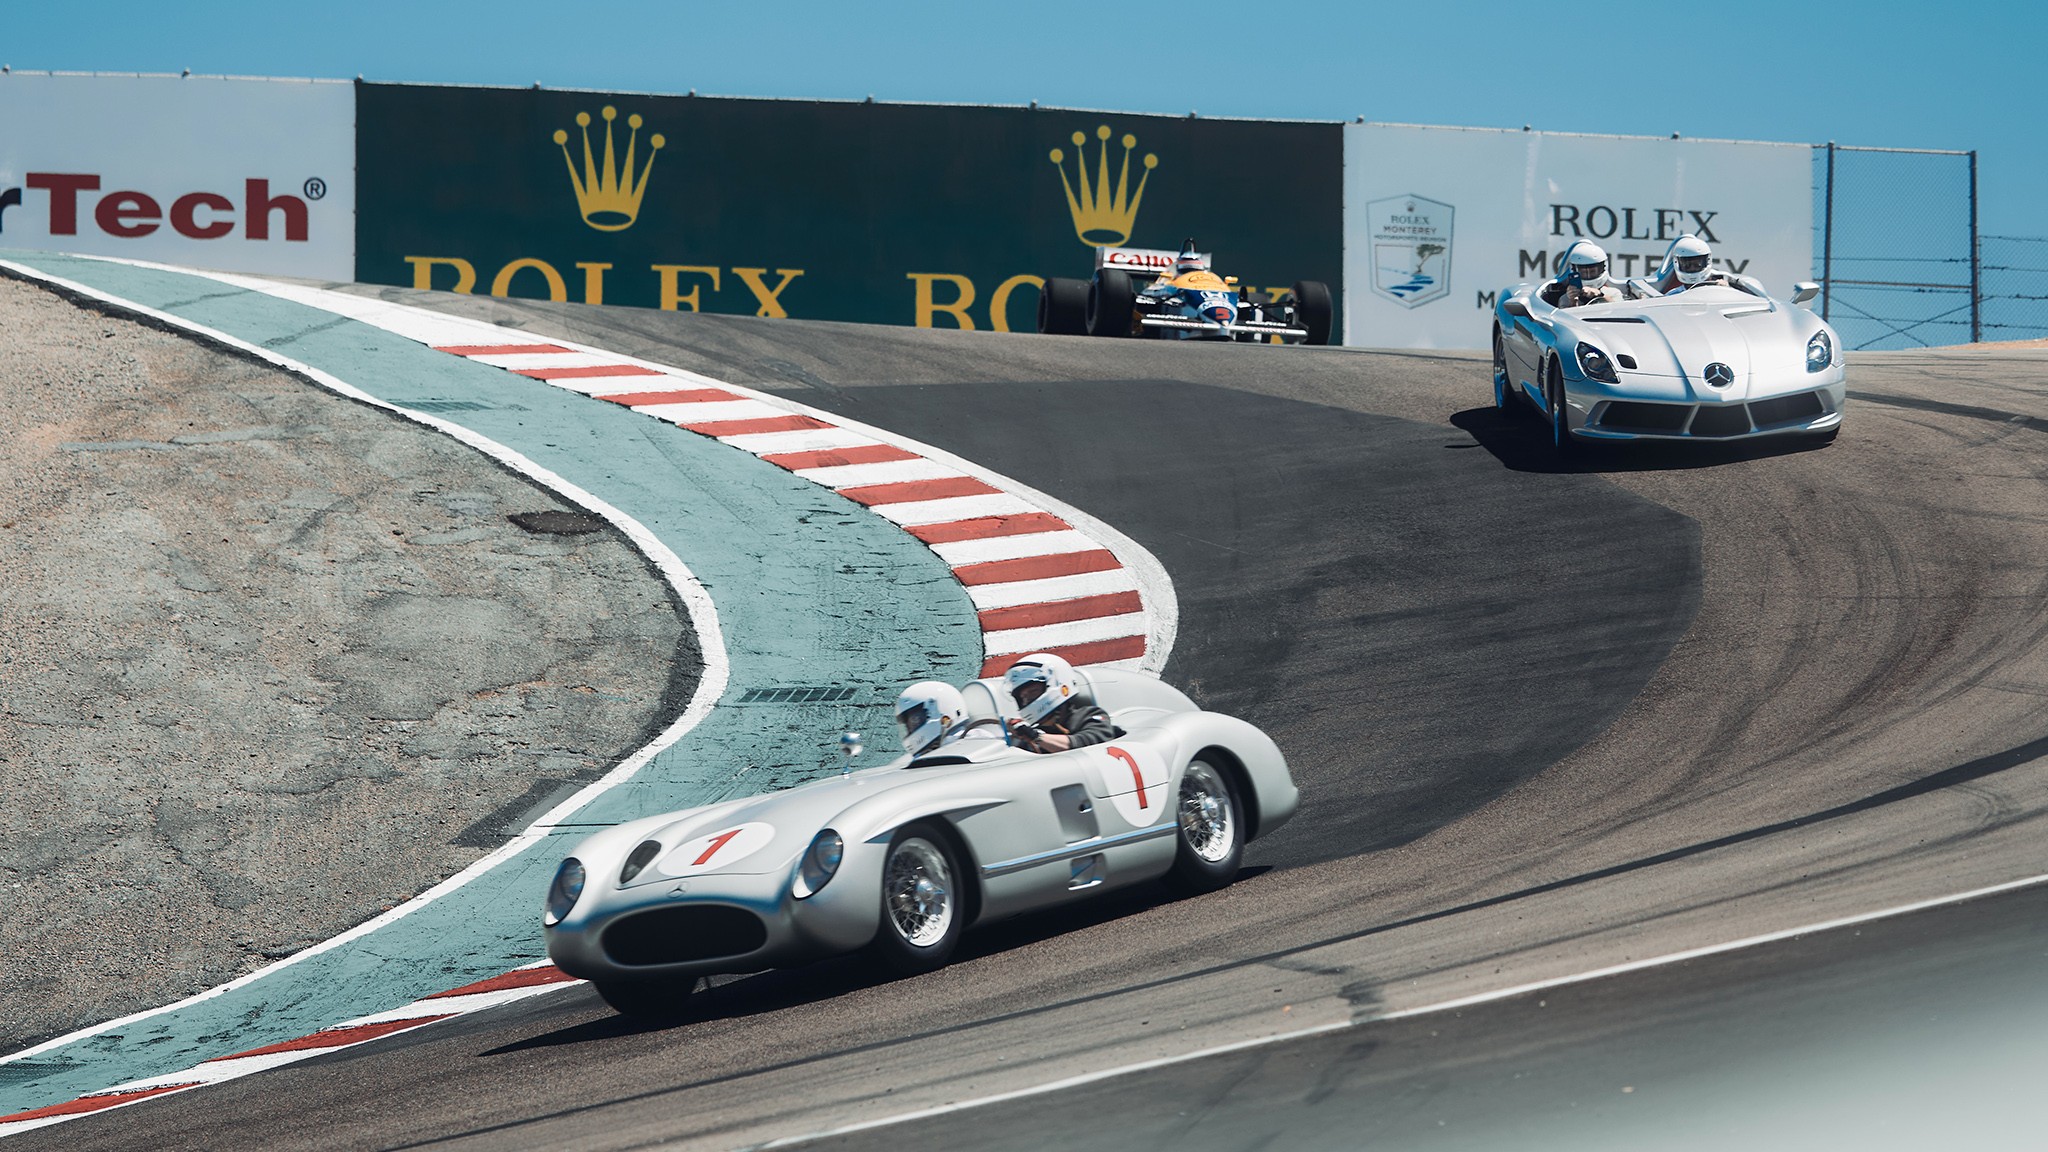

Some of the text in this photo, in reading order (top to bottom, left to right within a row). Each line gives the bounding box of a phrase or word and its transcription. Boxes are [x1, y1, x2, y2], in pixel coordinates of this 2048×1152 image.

[1383, 226, 1438, 235] MONTEREY
[1390, 215, 1431, 225] ROLEX
[1549, 203, 1722, 244] ROLEX
[1108, 252, 1174, 268] Cano
[1106, 746, 1149, 809] 1
[691, 828, 744, 866] 1
